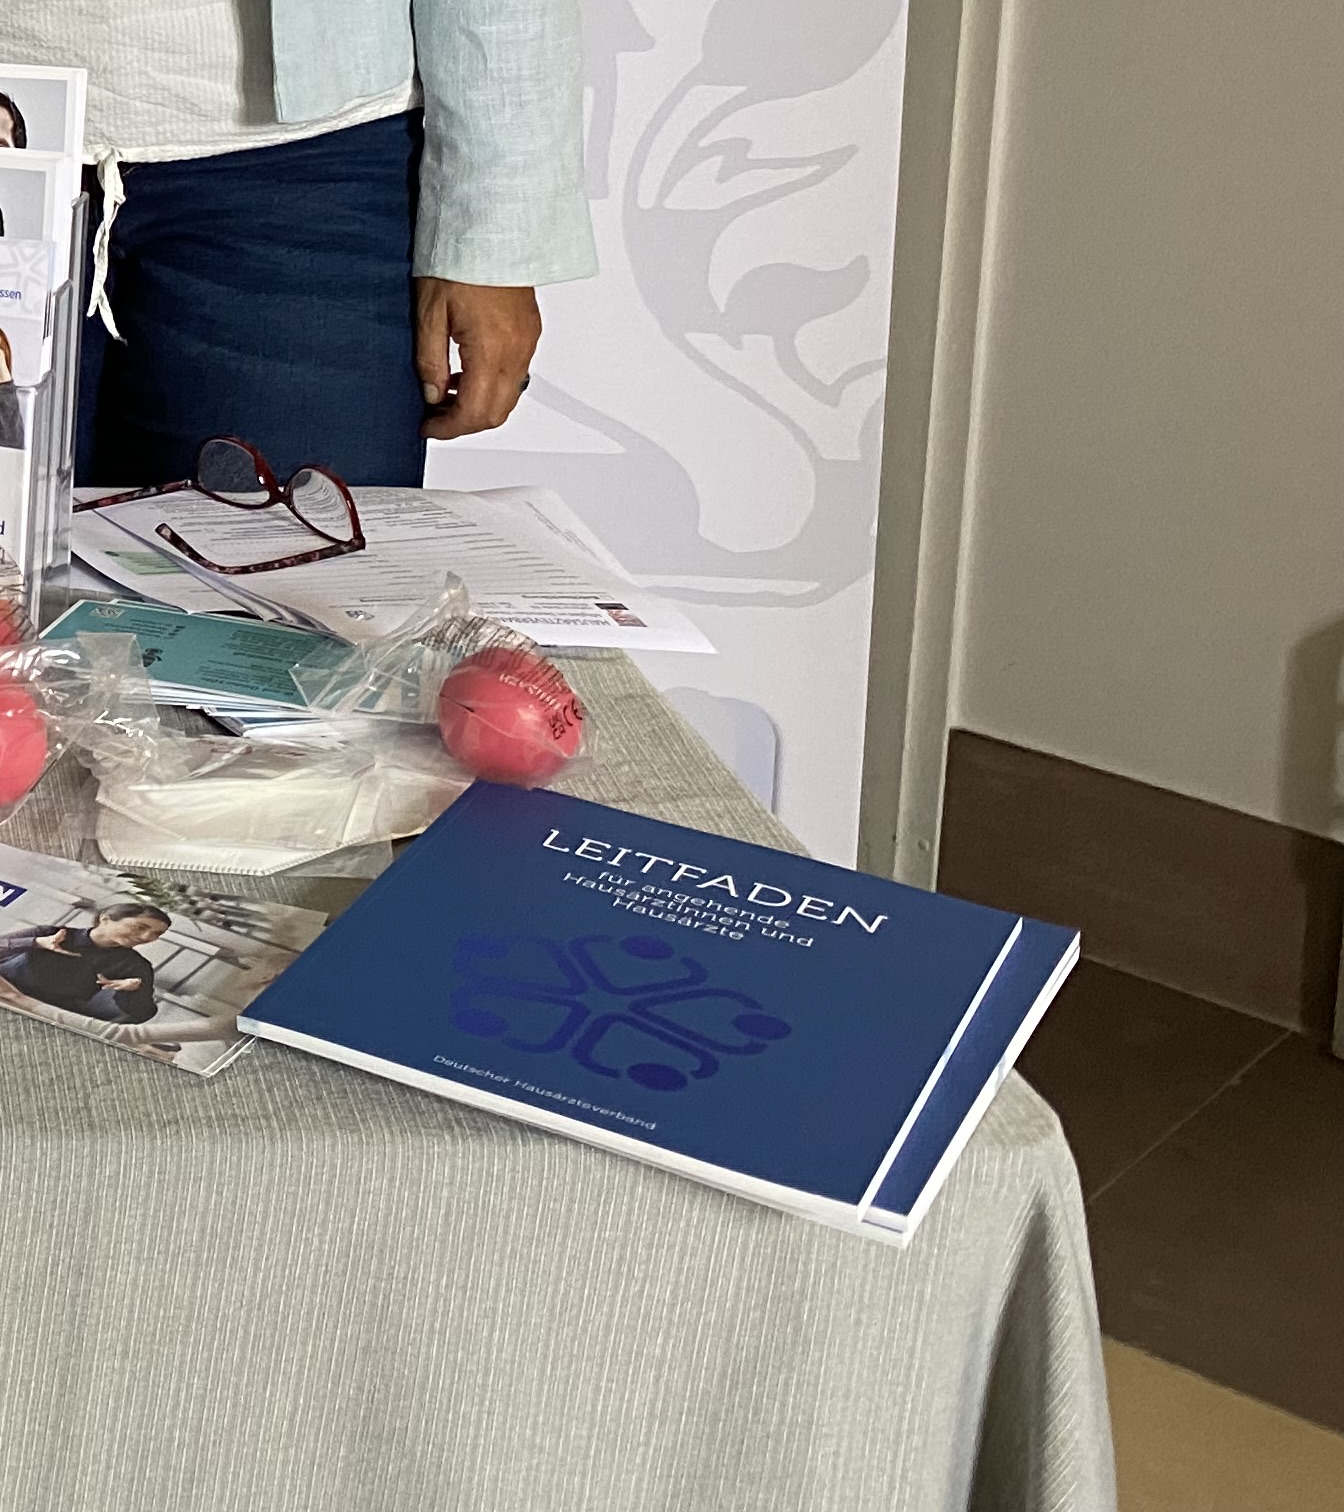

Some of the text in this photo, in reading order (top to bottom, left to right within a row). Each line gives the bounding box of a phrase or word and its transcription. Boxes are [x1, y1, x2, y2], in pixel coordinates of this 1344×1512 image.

[542, 828, 888, 935] LEITFADEN
[562, 871, 814, 948] Hausärztinnen und
[598, 871, 790, 930] für angehende
[613, 897, 744, 941] Hausärzte
[433, 1054, 657, 1131] Deutscher Hausärzteverband
